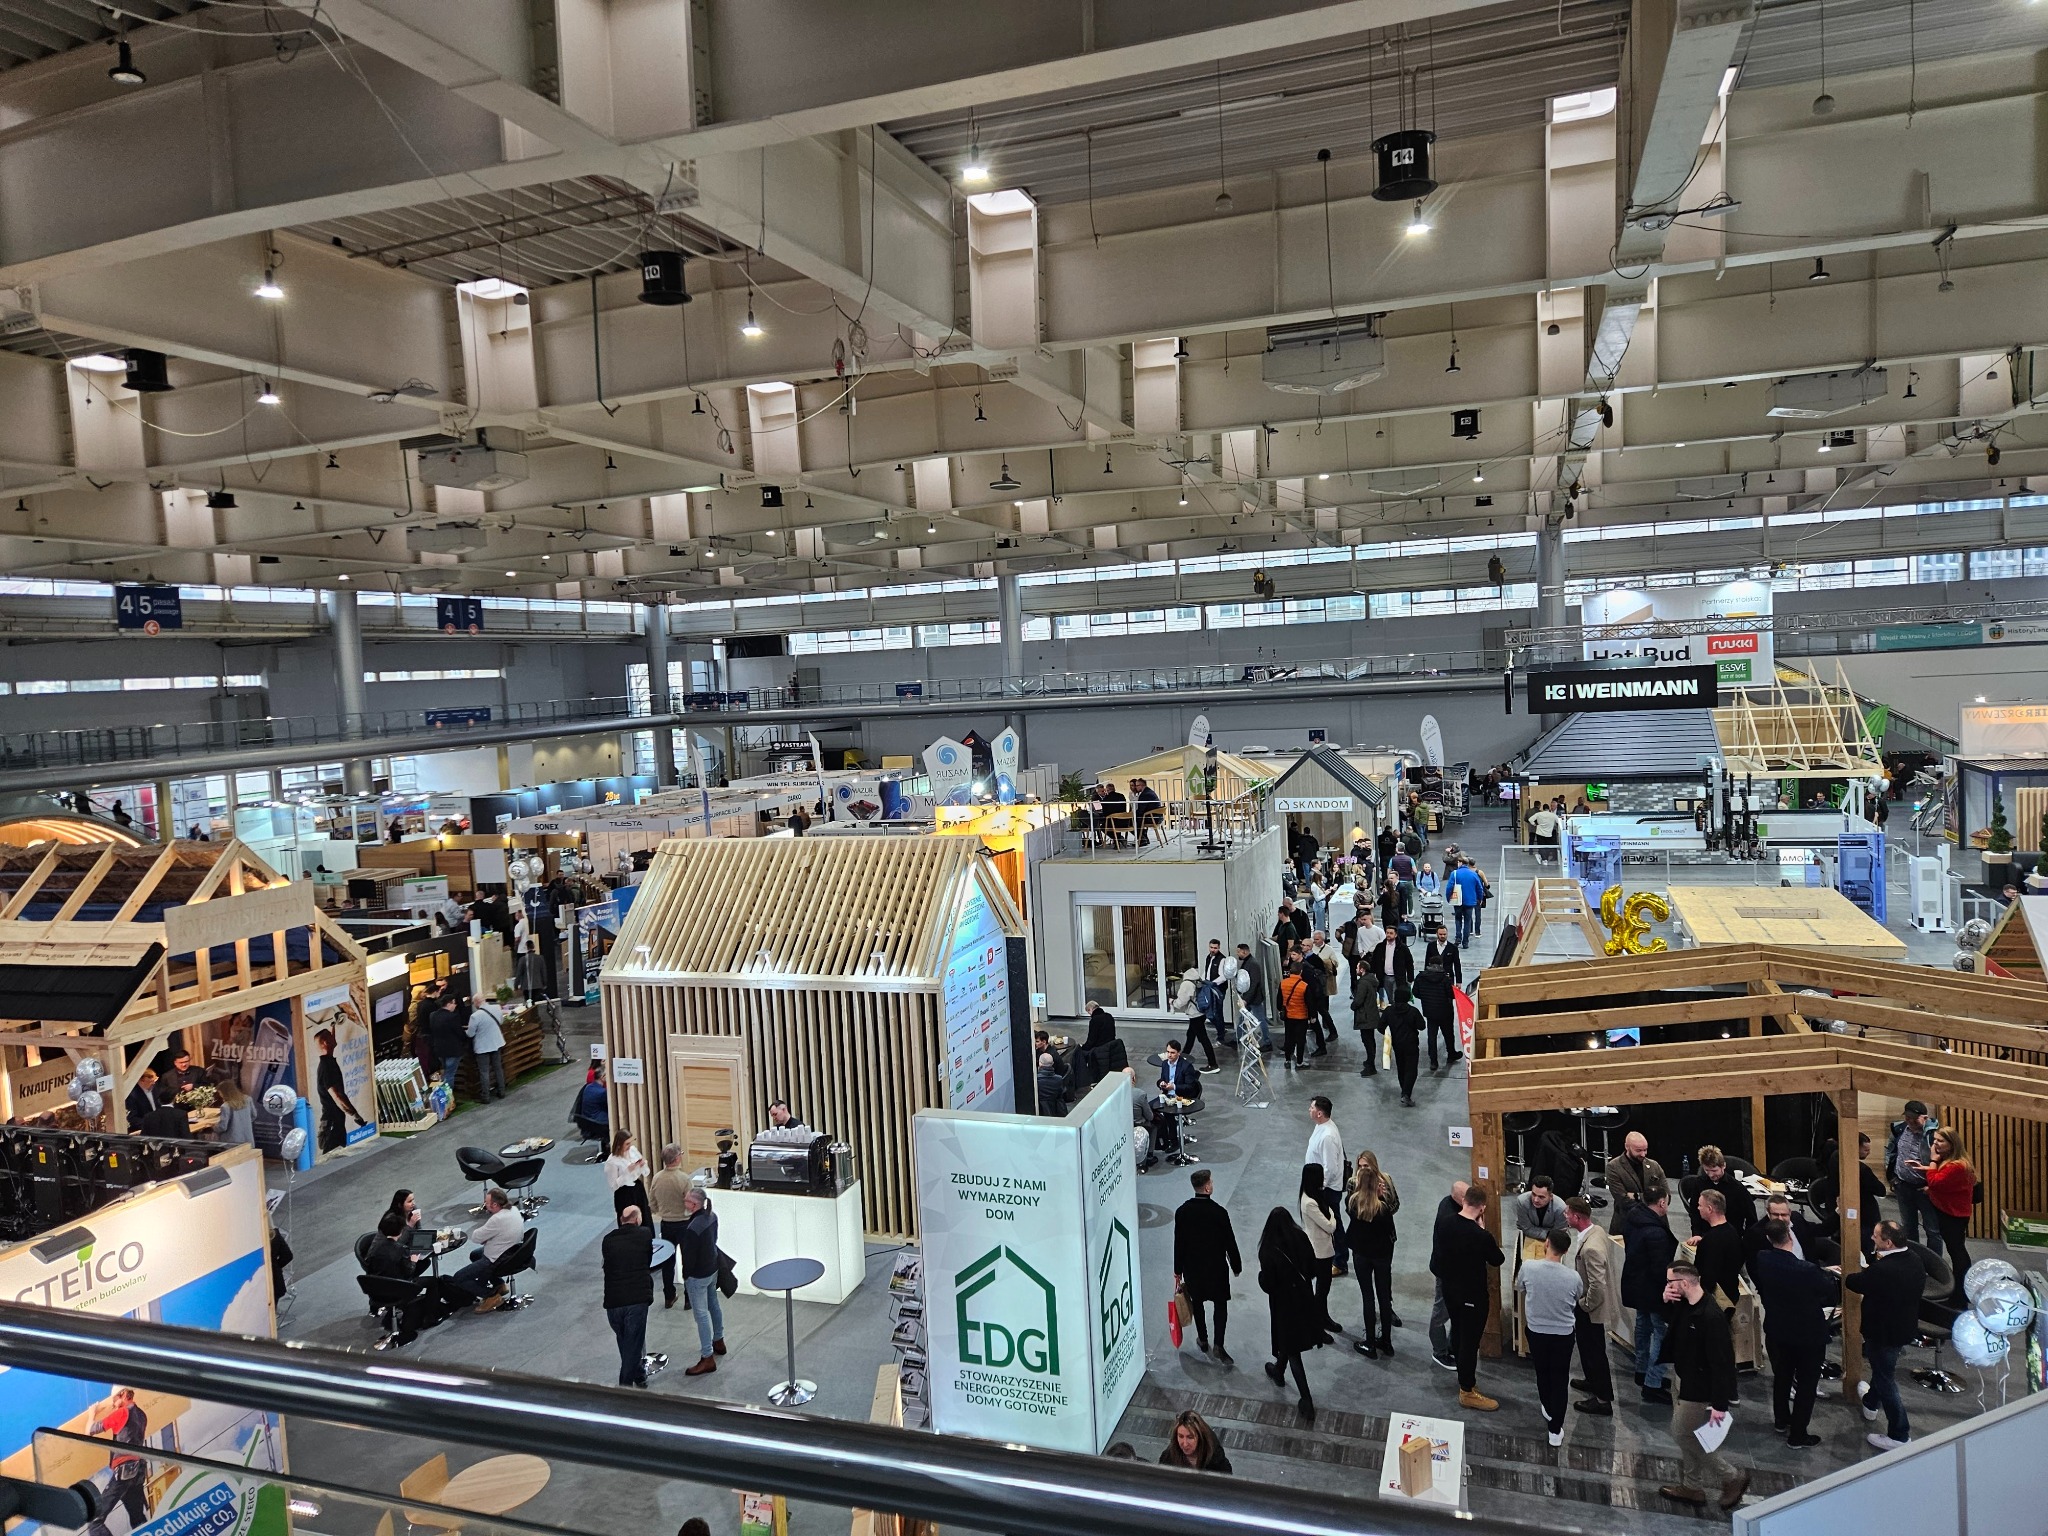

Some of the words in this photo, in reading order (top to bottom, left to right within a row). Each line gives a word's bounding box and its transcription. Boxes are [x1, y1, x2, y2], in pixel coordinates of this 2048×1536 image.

[1394, 149, 1413, 164] 14
[645, 267, 659, 277] 10
[1461, 417, 1471, 425] 13
[120, 595, 134, 614] 4
[140, 596, 152, 614] 5
[445, 604, 454, 618] 4
[468, 605, 476, 619] 5
[1712, 639, 1753, 649] ruukki
[1720, 663, 1746, 672] ESSVE
[1574, 679, 1698, 699] WEINMANN
[997, 757, 1015, 766] MAZUR
[1293, 800, 1349, 810] SKANDOM
[534, 823, 559, 831] SONEX
[211, 1038, 244, 1063] Złoty
[246, 1041, 289, 1063] środek
[950, 1173, 1000, 1188] ZBUDUJ
[1003, 1177, 1010, 1189] Z
[1014, 1179, 1046, 1191] NAMI
[958, 1189, 1040, 1207] WYMARZONY
[986, 1208, 1014, 1221] DOM
[100, 1273, 148, 1300] budowlany
[960, 1370, 1061, 1393] STOWARZYSZENIE
[954, 1381, 1068, 1406] ENERGOOSZCZĘDNE
[966, 1394, 1001, 1408] DOMY
[1004, 1400, 1057, 1416] GOTOWE
